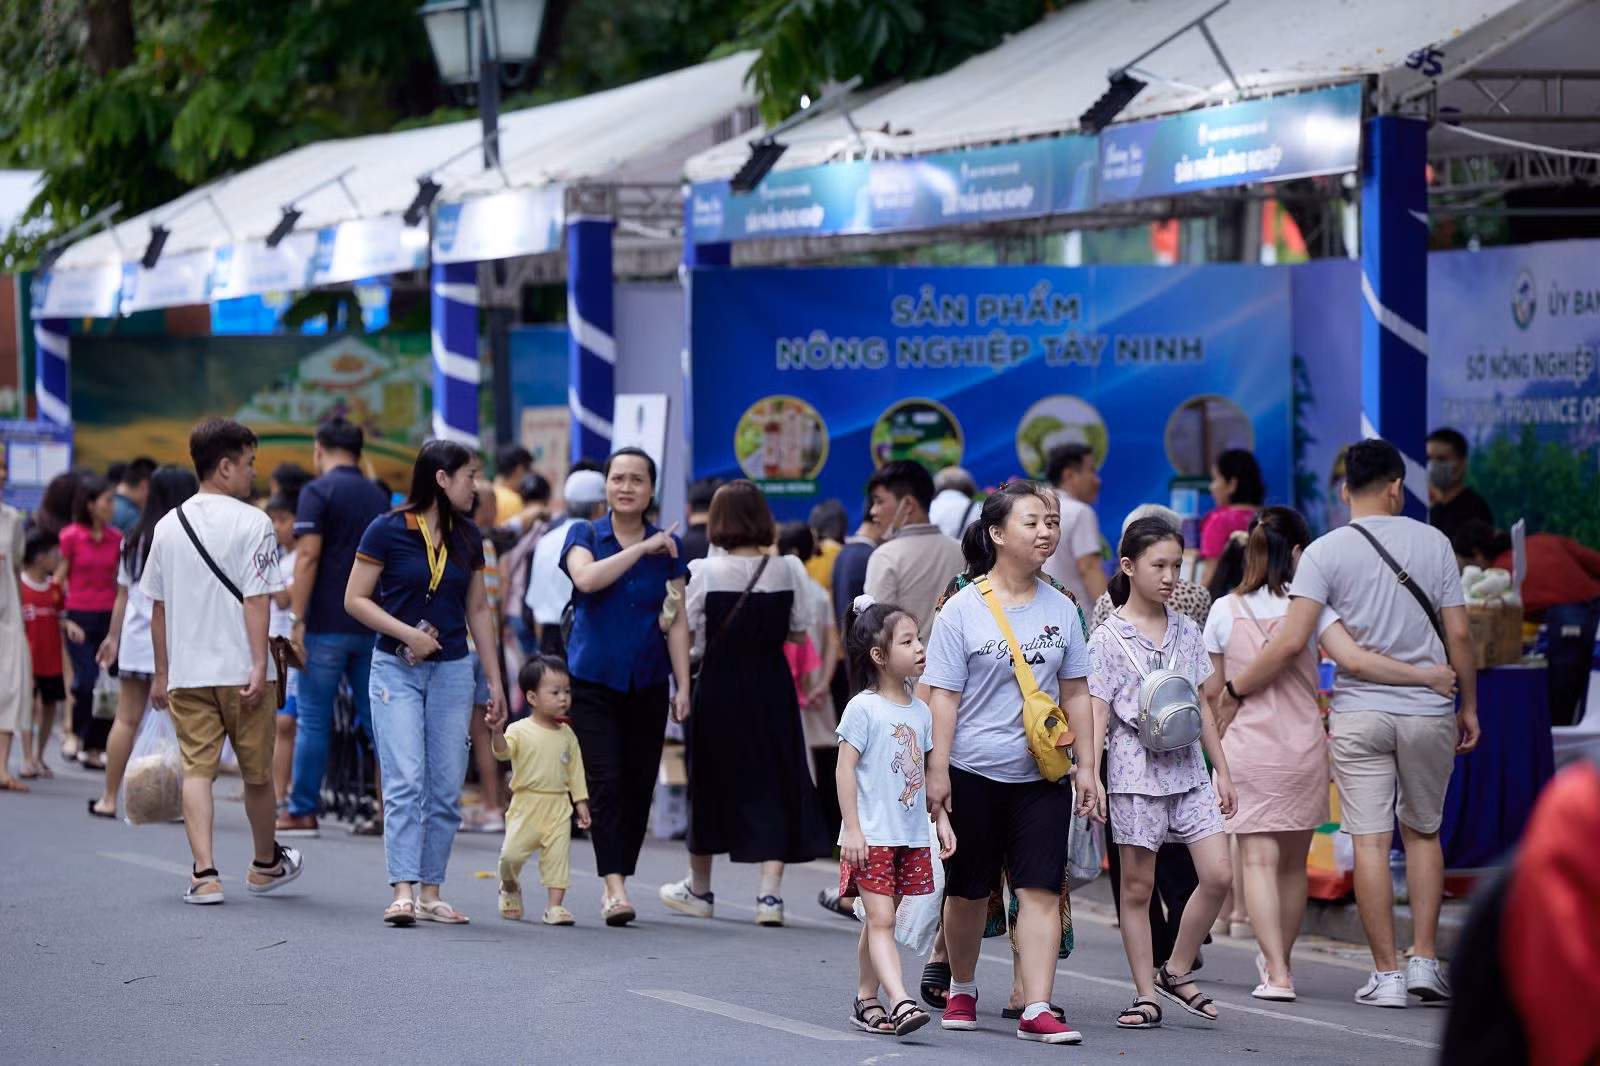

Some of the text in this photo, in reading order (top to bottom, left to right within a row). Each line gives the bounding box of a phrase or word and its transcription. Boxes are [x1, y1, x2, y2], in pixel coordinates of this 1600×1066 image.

[891, 282, 1081, 326] SẢN PHẨM
[776, 328, 1204, 374] NÔNG NGHIỆP TÂY NINH
